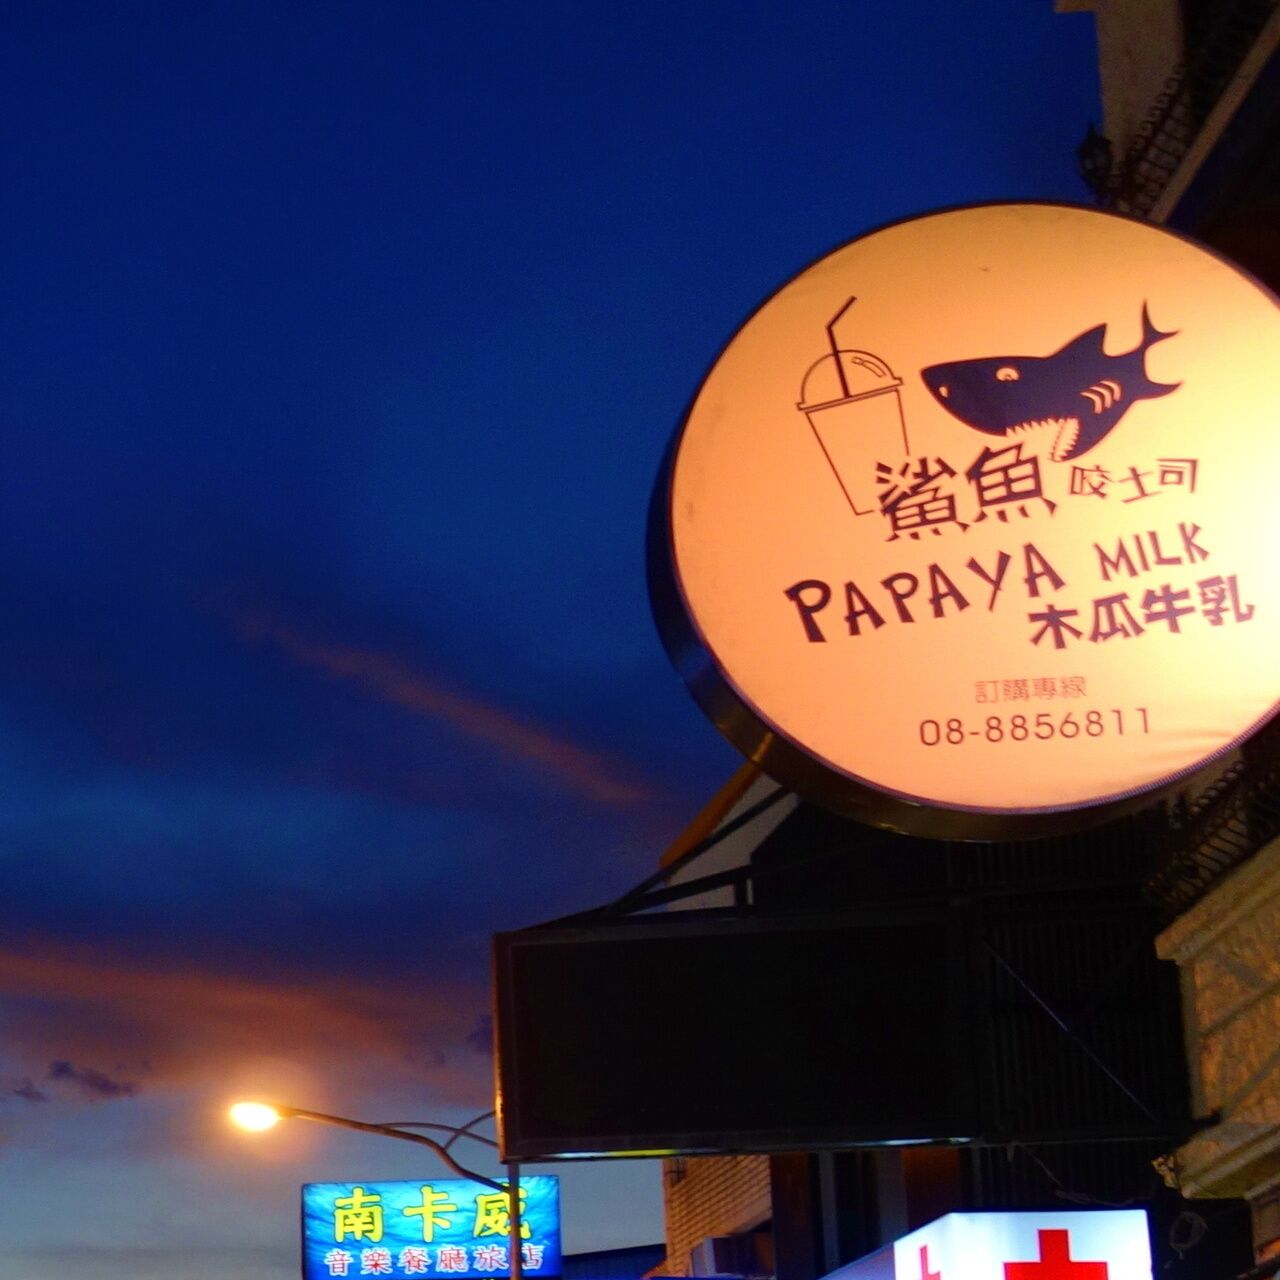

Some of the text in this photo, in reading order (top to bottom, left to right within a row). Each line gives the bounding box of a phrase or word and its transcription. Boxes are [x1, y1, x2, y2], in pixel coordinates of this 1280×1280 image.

[783, 521, 1211, 643] PAPAYA MILK
[1028, 573, 1256, 650] 木瓜牛乳
[919, 706, 1151, 746] 08-8856811
[332, 1181, 533, 1244] 南卡威
